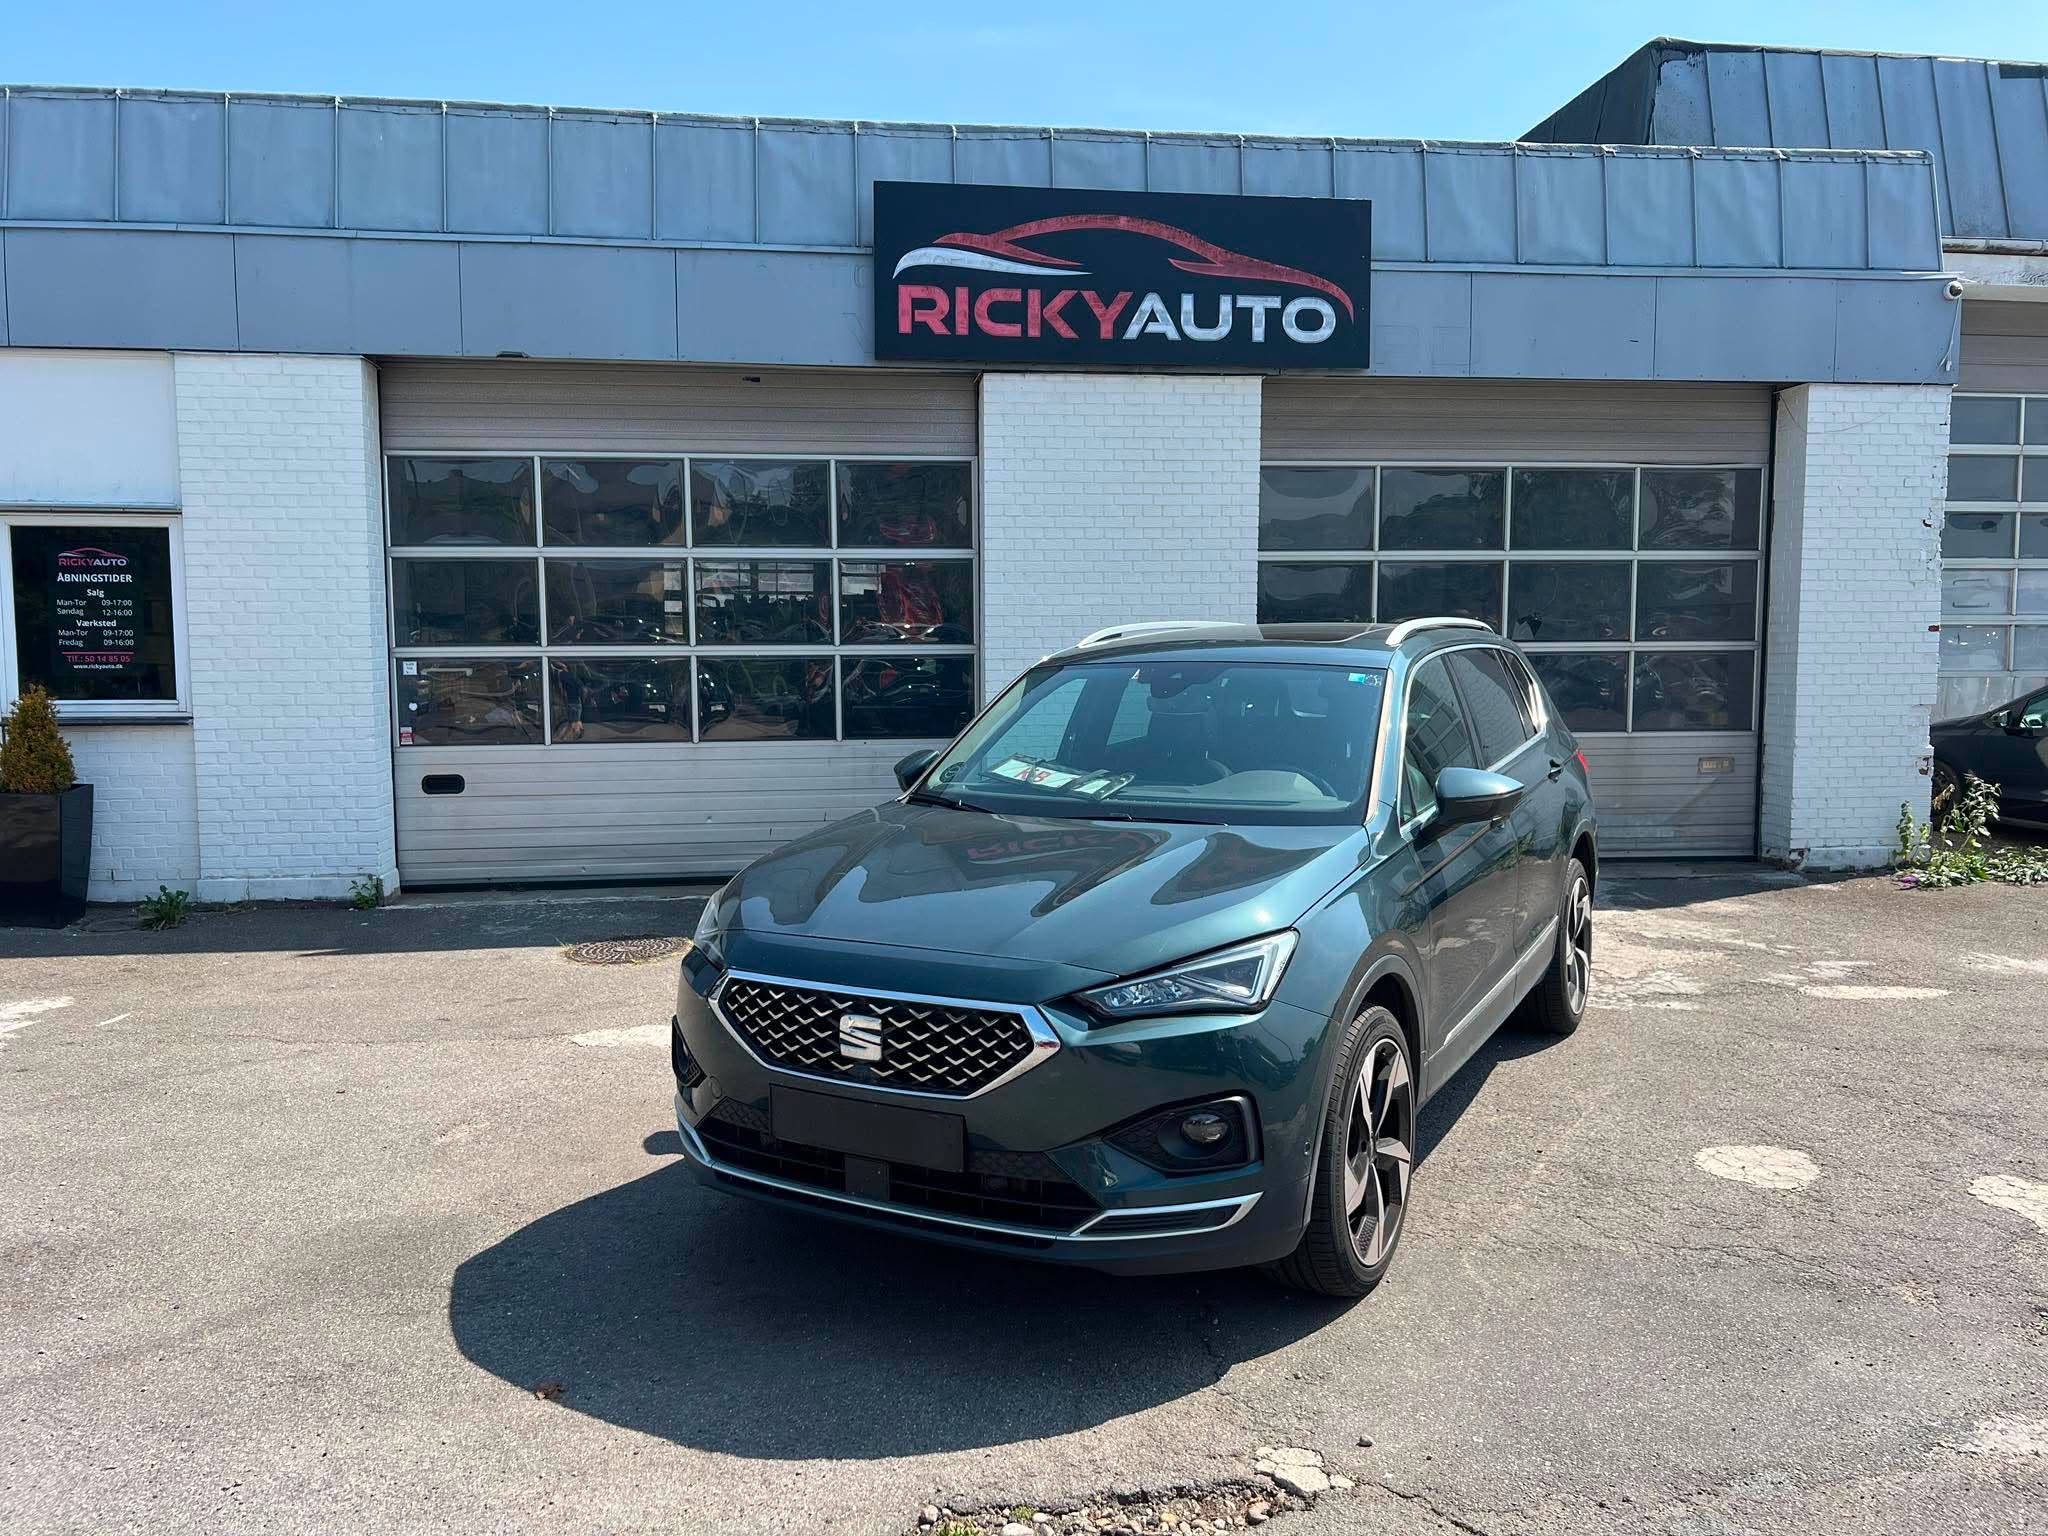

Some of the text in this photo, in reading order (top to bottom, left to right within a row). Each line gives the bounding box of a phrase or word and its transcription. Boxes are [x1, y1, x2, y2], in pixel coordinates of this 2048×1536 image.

[897, 284, 1337, 344] RICKYAUTO
[58, 558, 127, 566] RICKYAUTO
[56, 572, 133, 583] ÅBNINGSTIDER
[86, 588, 105, 598] Salg
[56, 607, 84, 616] Søndag
[76, 619, 117, 627] Værksted
[58, 638, 84, 647] Fredag
